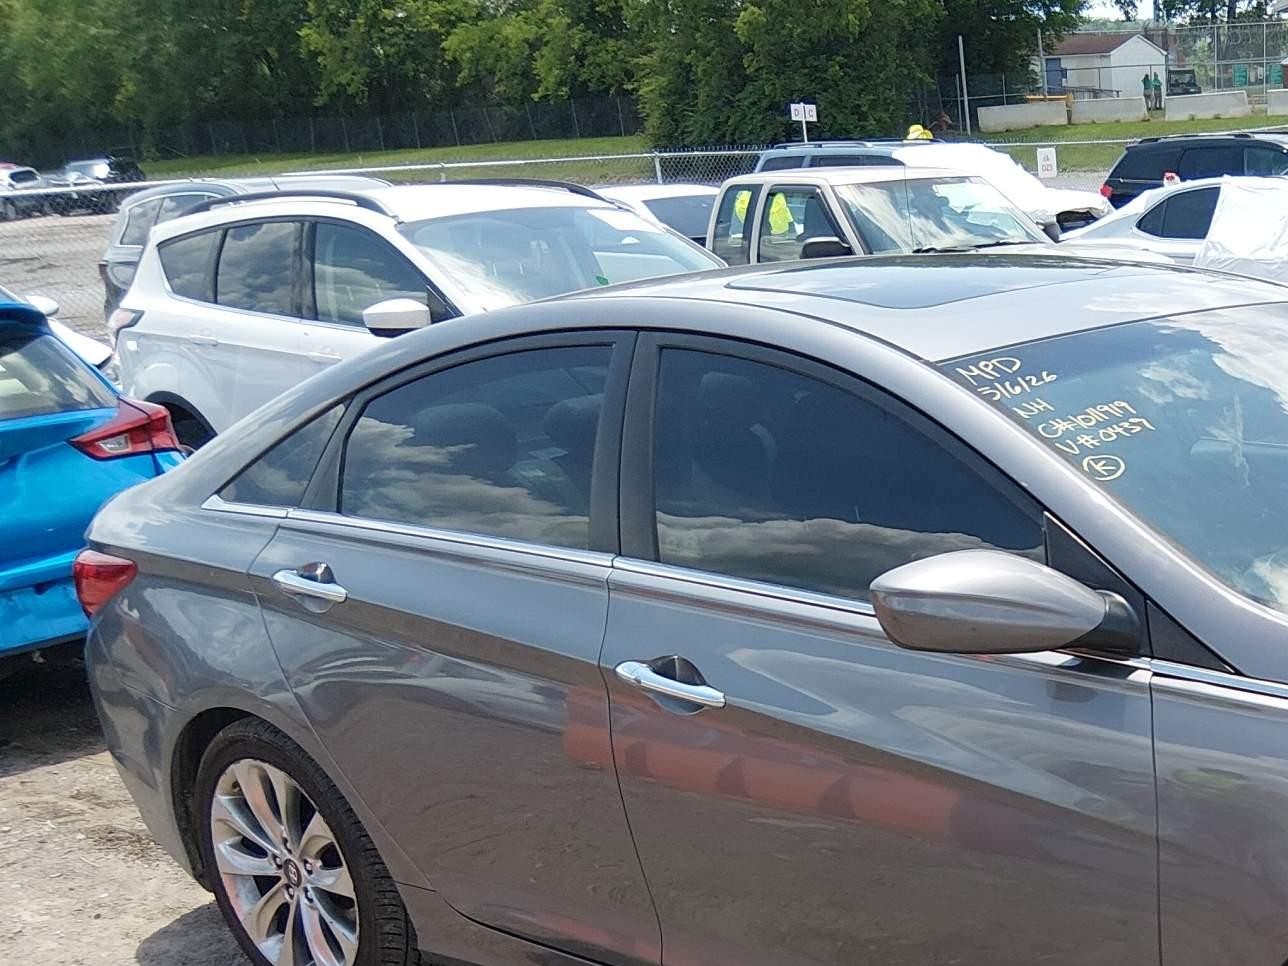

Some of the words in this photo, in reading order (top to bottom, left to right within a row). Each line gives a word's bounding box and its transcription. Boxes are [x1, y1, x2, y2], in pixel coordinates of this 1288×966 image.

[955, 357, 1021, 386] MPD
[977, 371, 1057, 400] 5/6/26
[1012, 398, 1055, 418] NH
